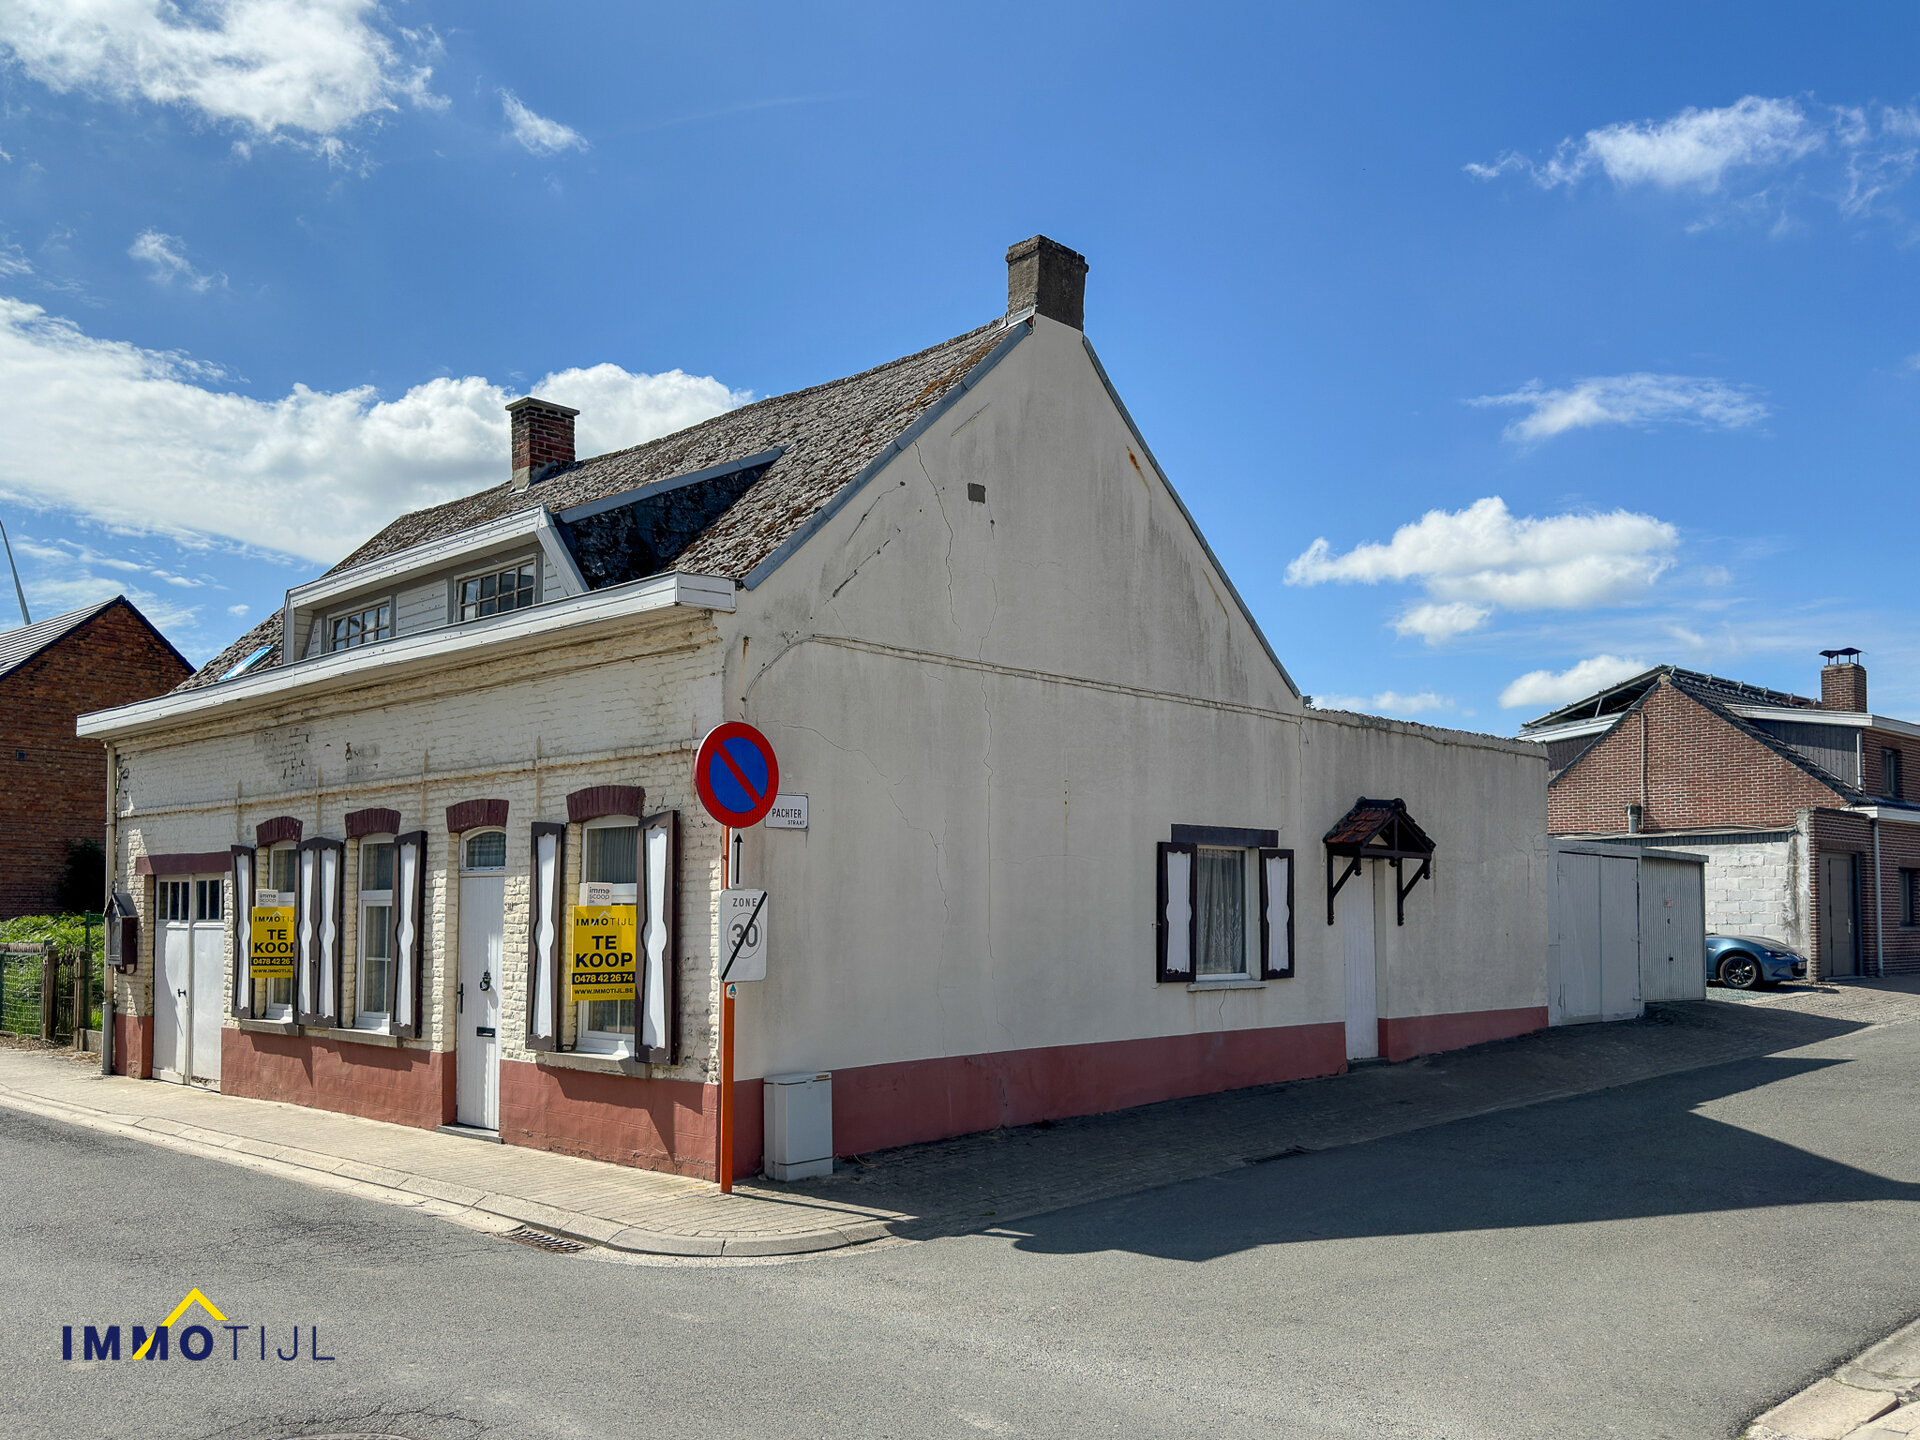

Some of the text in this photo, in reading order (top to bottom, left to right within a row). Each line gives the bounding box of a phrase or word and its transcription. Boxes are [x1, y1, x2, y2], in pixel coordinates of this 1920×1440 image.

[771, 808, 802, 818] PACHTER
[732, 898, 758, 908] ZONE
[576, 917, 634, 926] IMMOTIJL
[266, 929, 287, 940] TE
[731, 923, 758, 948] 30
[591, 935, 617, 950] TE
[575, 952, 633, 968] KOOP
[574, 973, 634, 983] 0478 42 26 74
